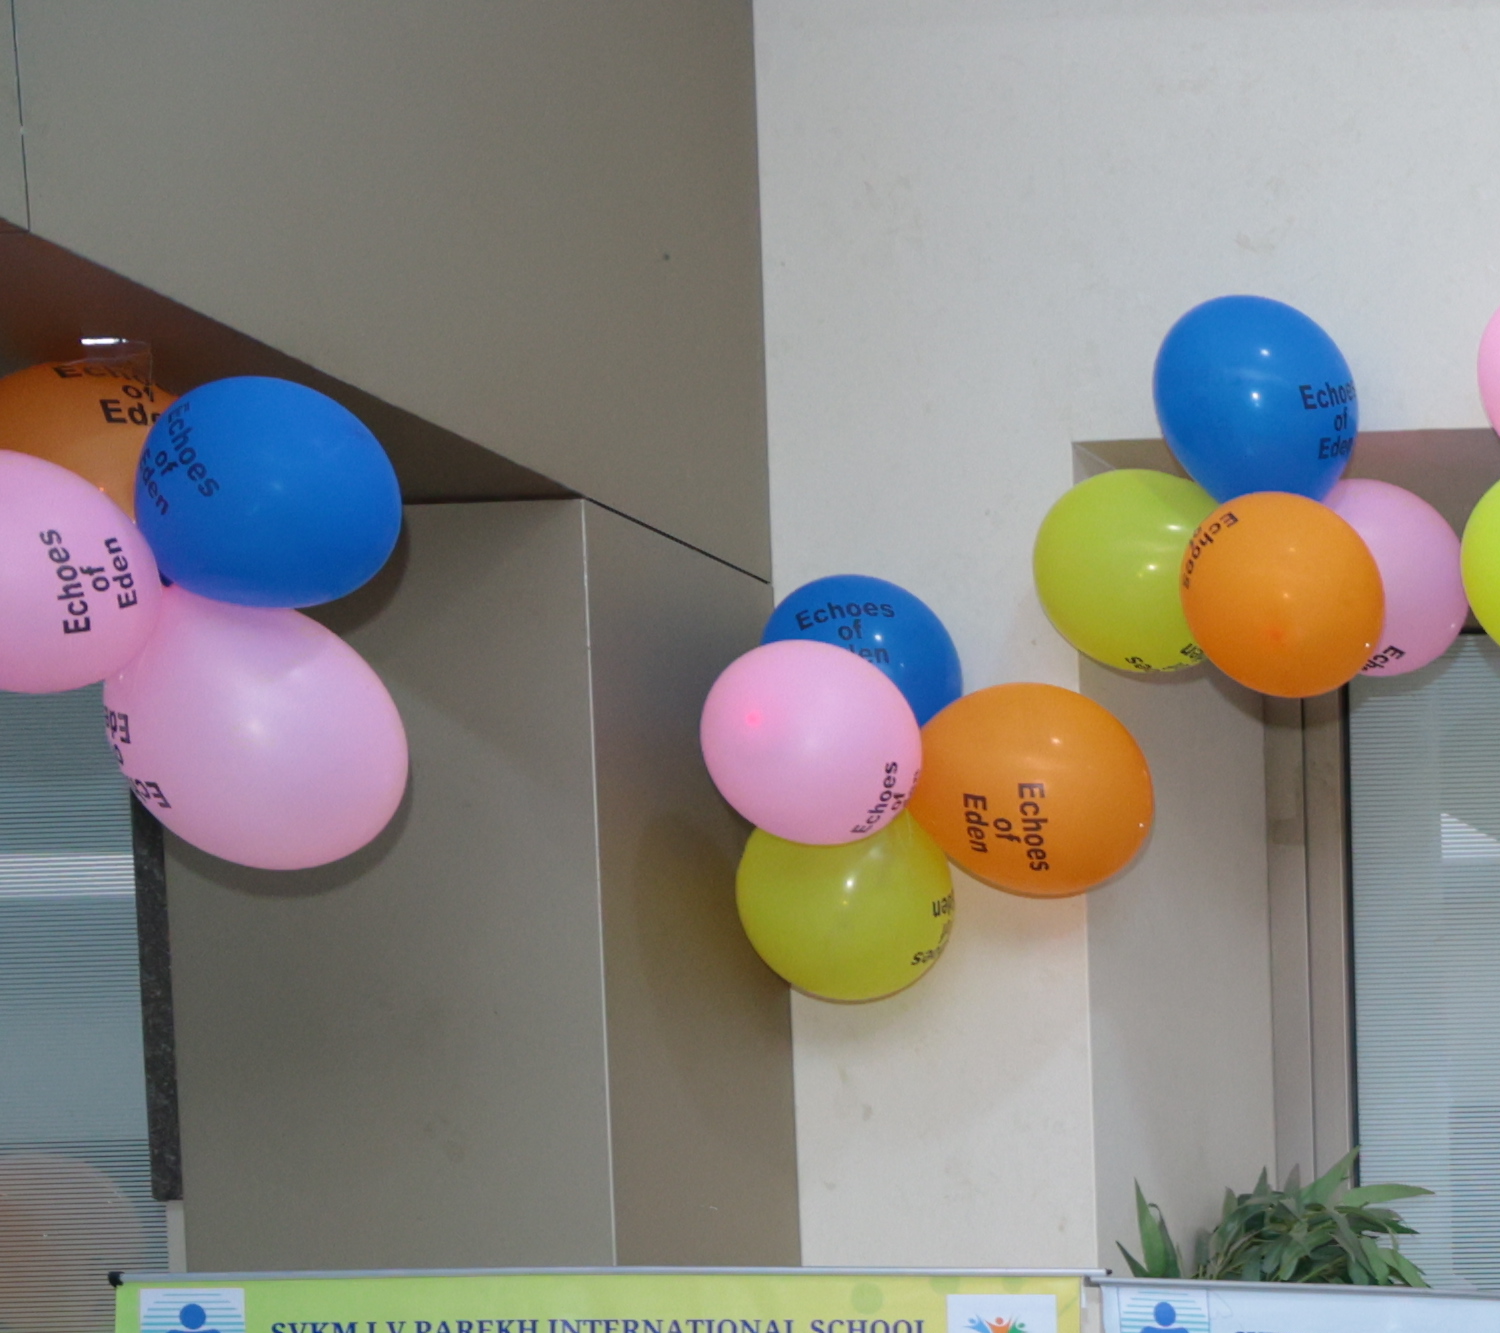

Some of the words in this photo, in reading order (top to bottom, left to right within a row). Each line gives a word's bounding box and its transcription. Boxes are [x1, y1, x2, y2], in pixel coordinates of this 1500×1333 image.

[39, 528, 92, 636] Echoes
[79, 565, 110, 594] of
[104, 536, 138, 611] Eden
